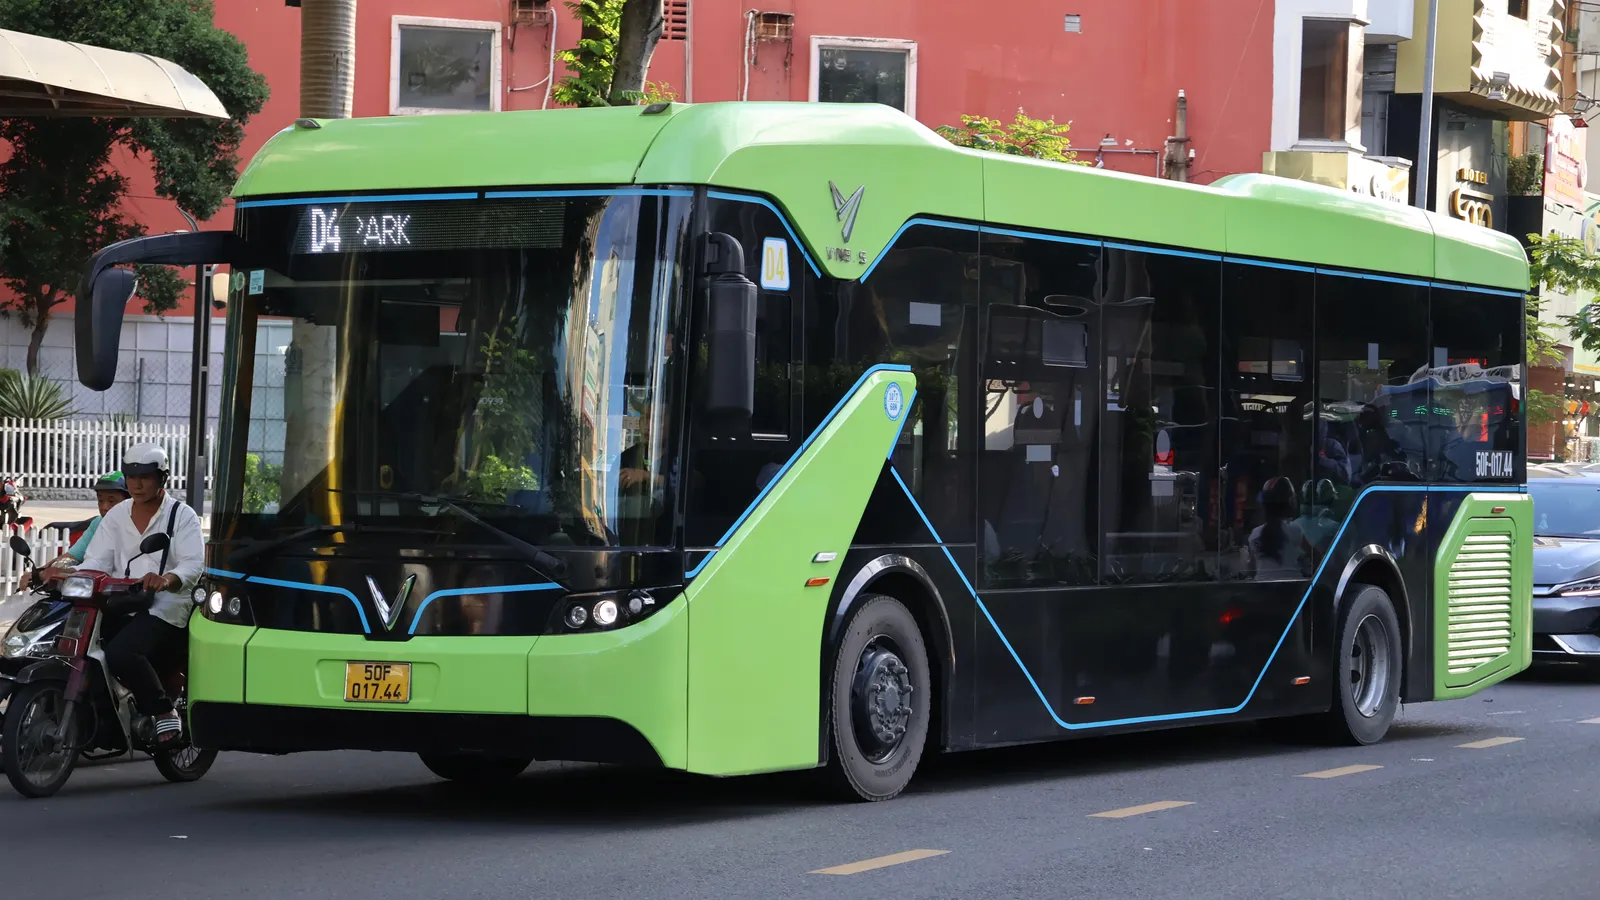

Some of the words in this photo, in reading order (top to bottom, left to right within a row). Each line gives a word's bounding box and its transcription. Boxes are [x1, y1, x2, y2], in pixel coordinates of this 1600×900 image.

[1459, 167, 1488, 184] HOTEL
[311, 207, 341, 252] D4
[765, 246, 785, 281] D4
[1475, 451, 1513, 477] 50F-017.44
[364, 664, 392, 681] 50F
[351, 682, 402, 699] 017.44
